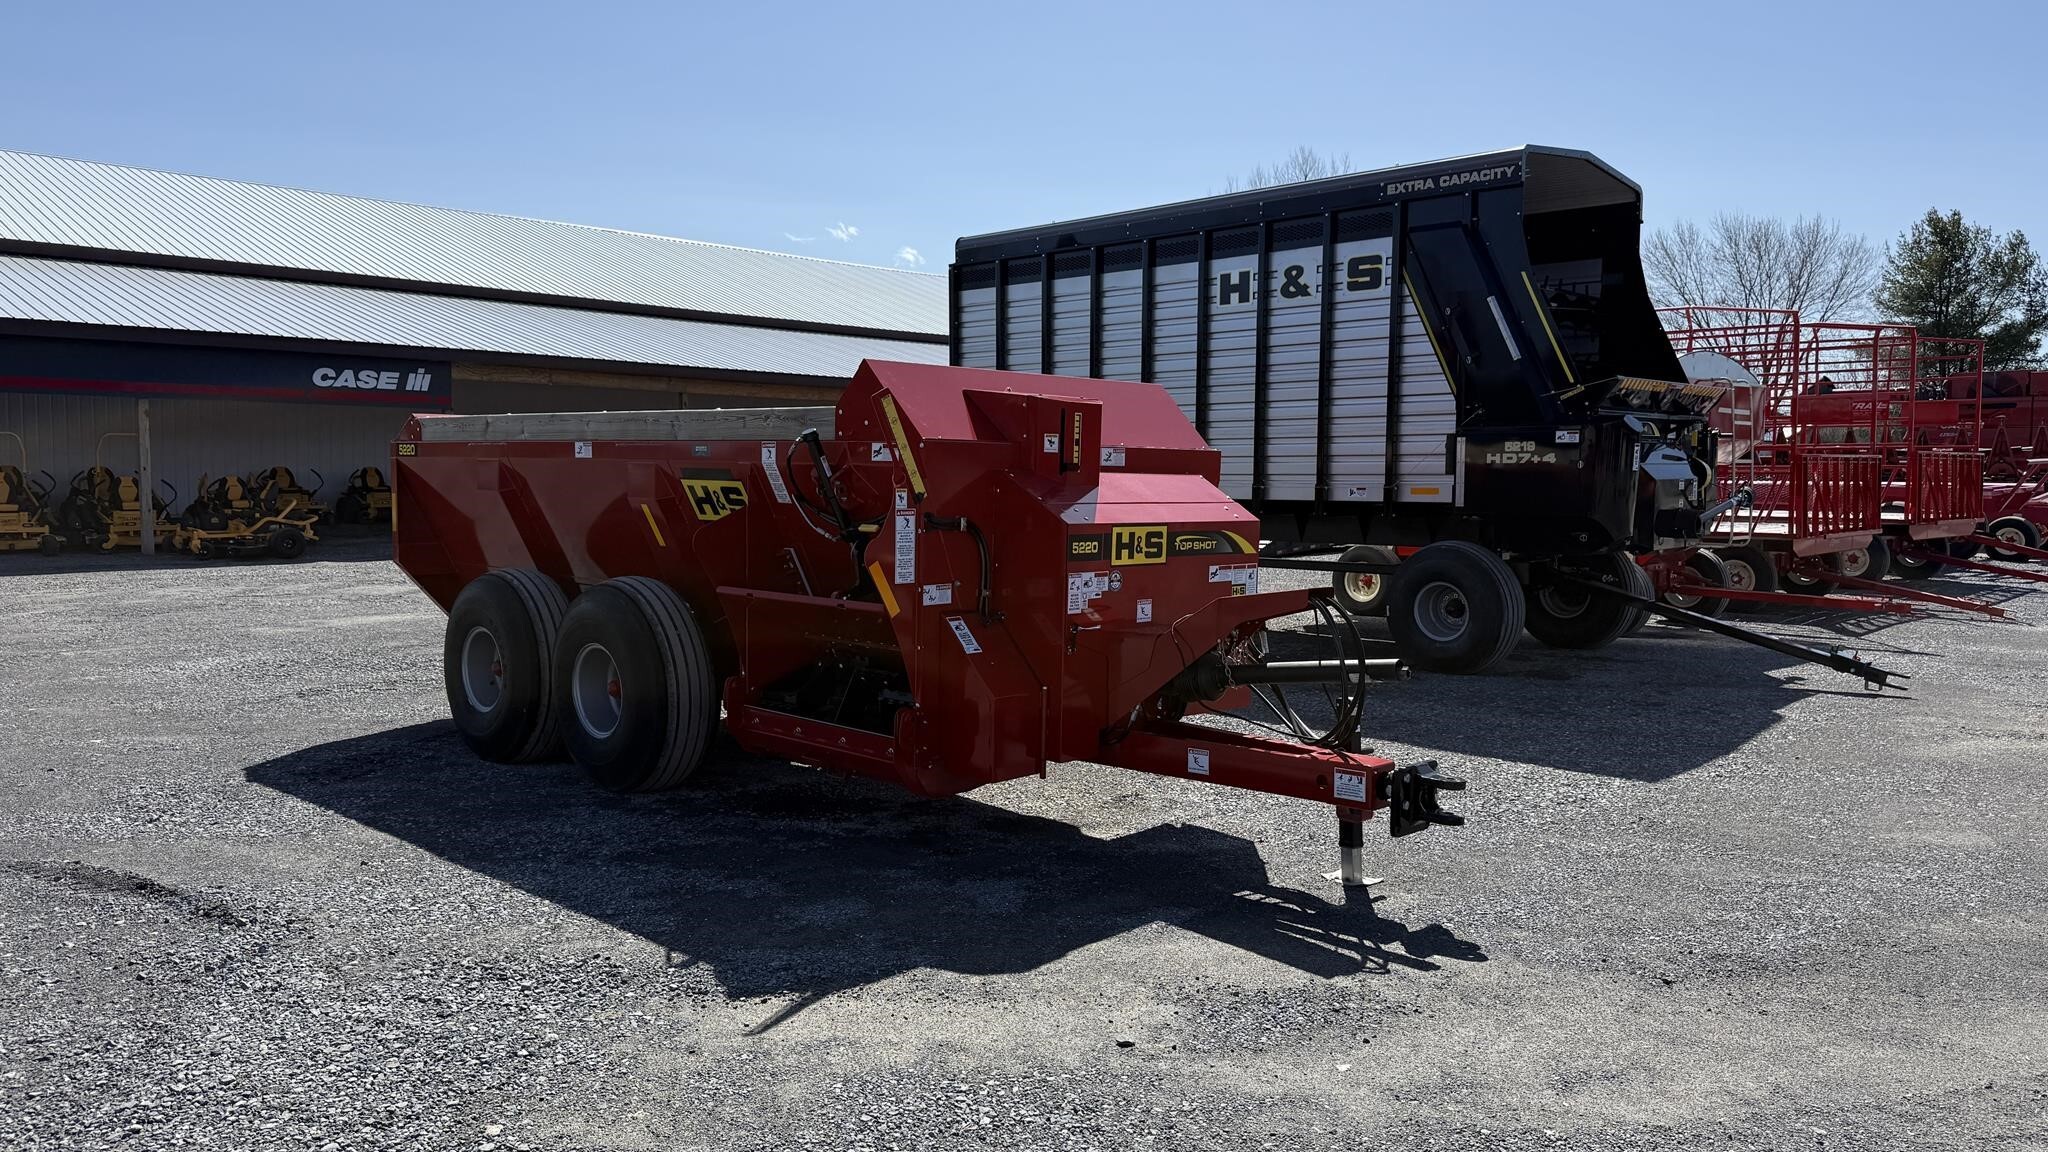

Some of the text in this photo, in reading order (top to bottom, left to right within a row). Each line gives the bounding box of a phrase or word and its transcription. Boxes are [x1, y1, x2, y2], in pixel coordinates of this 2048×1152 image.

[1387, 166, 1516, 195] EXTRA CAPACITY
[312, 367, 400, 390] CASE
[398, 444, 416, 455] 5220
[1486, 453, 1557, 464] HD7+4
[687, 485, 748, 516] H&S
[1072, 541, 1099, 554] 5220
[1115, 531, 1164, 560] H&S
